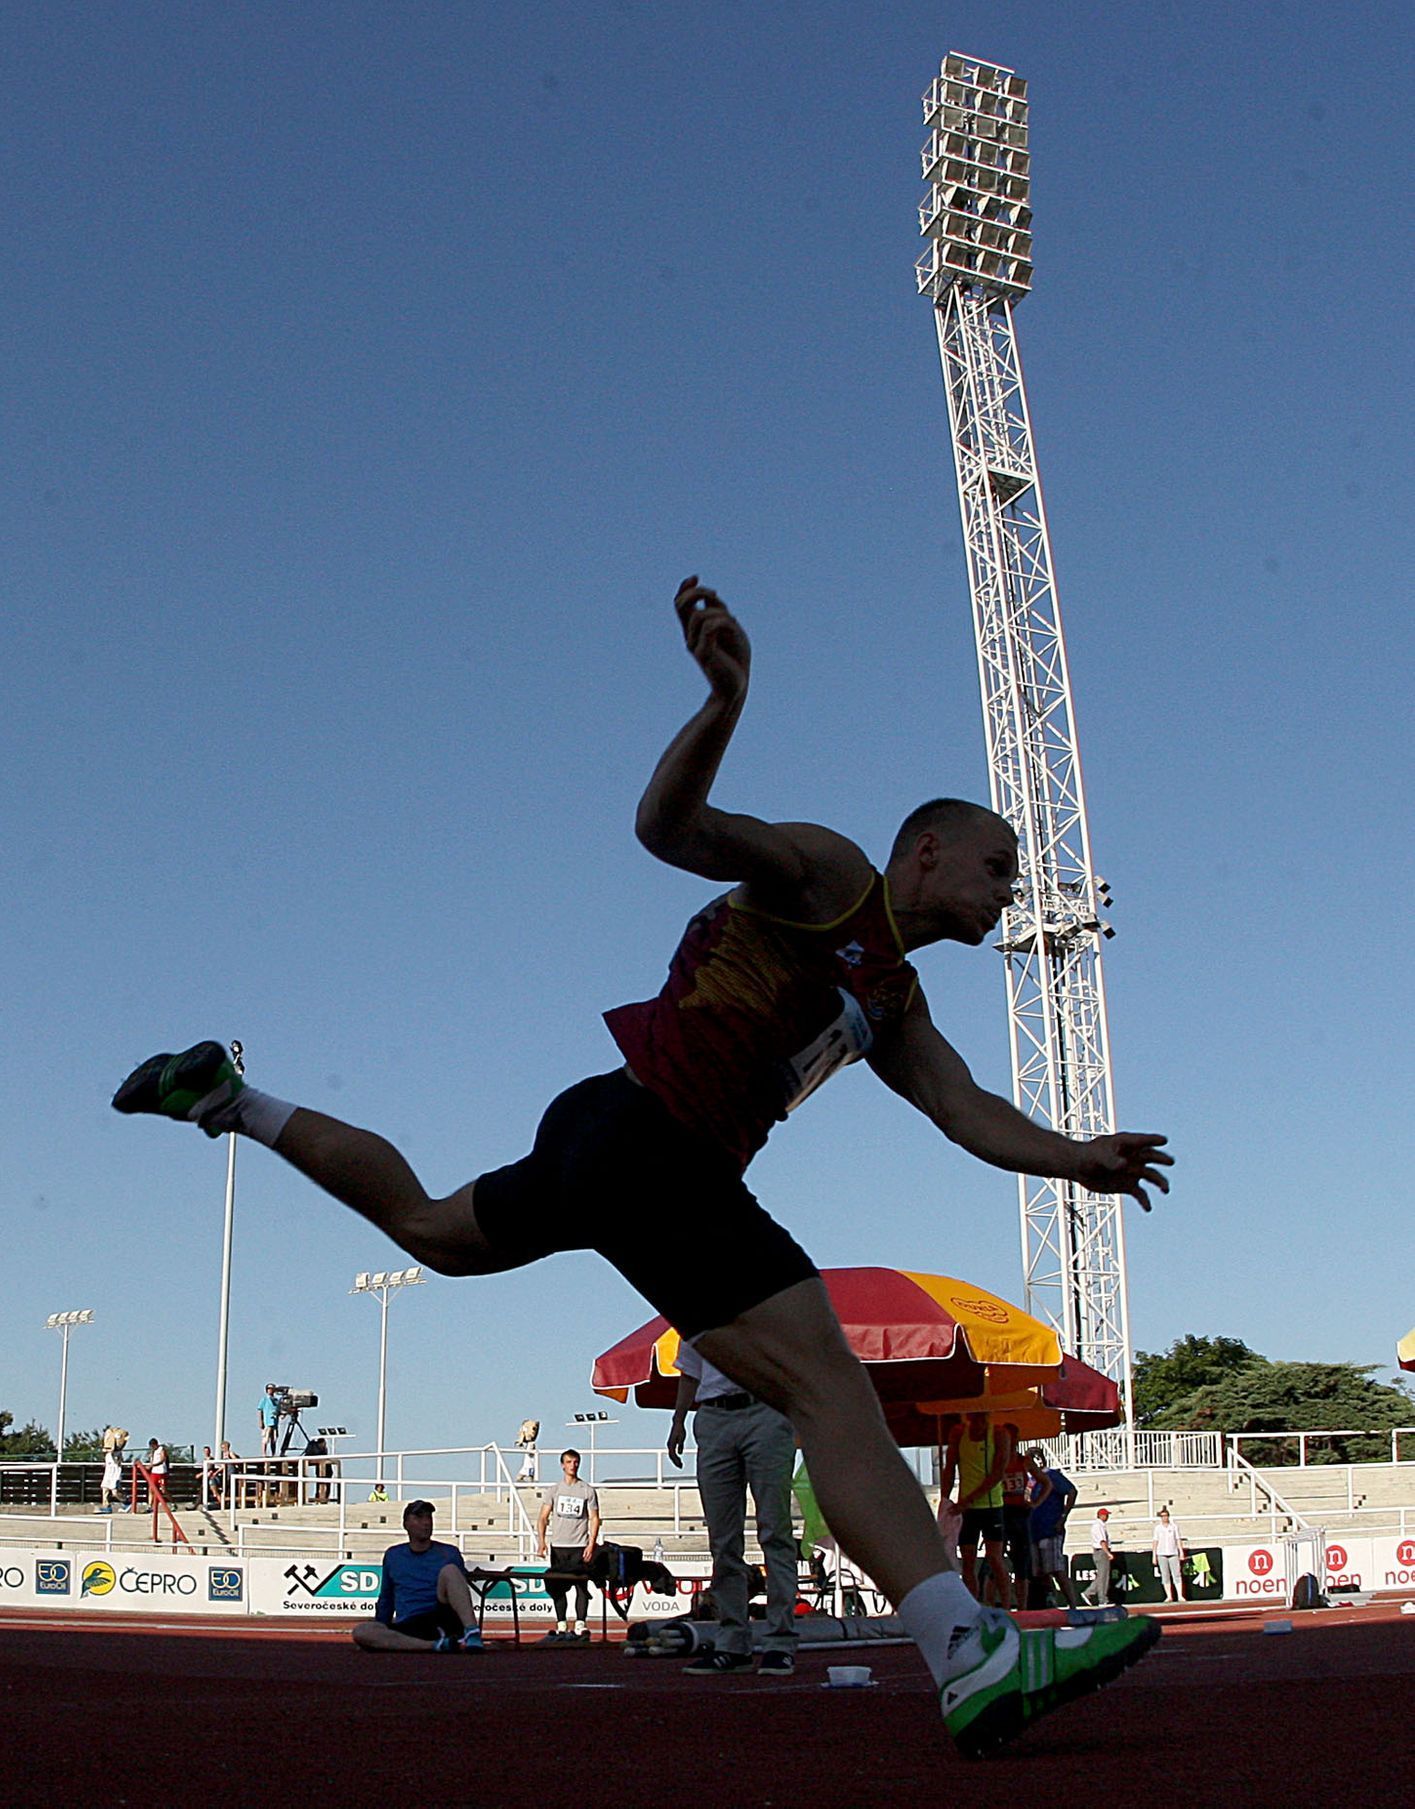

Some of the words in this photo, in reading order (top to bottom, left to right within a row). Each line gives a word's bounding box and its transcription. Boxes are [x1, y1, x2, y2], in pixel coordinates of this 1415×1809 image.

[560, 1502, 581, 1514] 134
[1253, 1554, 1269, 1570] n
[119, 1567, 197, 1595] ČEPRO
[340, 1570, 379, 1592] SD
[1236, 1578, 1287, 1595] noen
[1325, 1573, 1361, 1588] oen
[283, 1600, 357, 1611] Severočeské
[529, 1602, 553, 1614] doly
[642, 1601, 680, 1611] VODA
